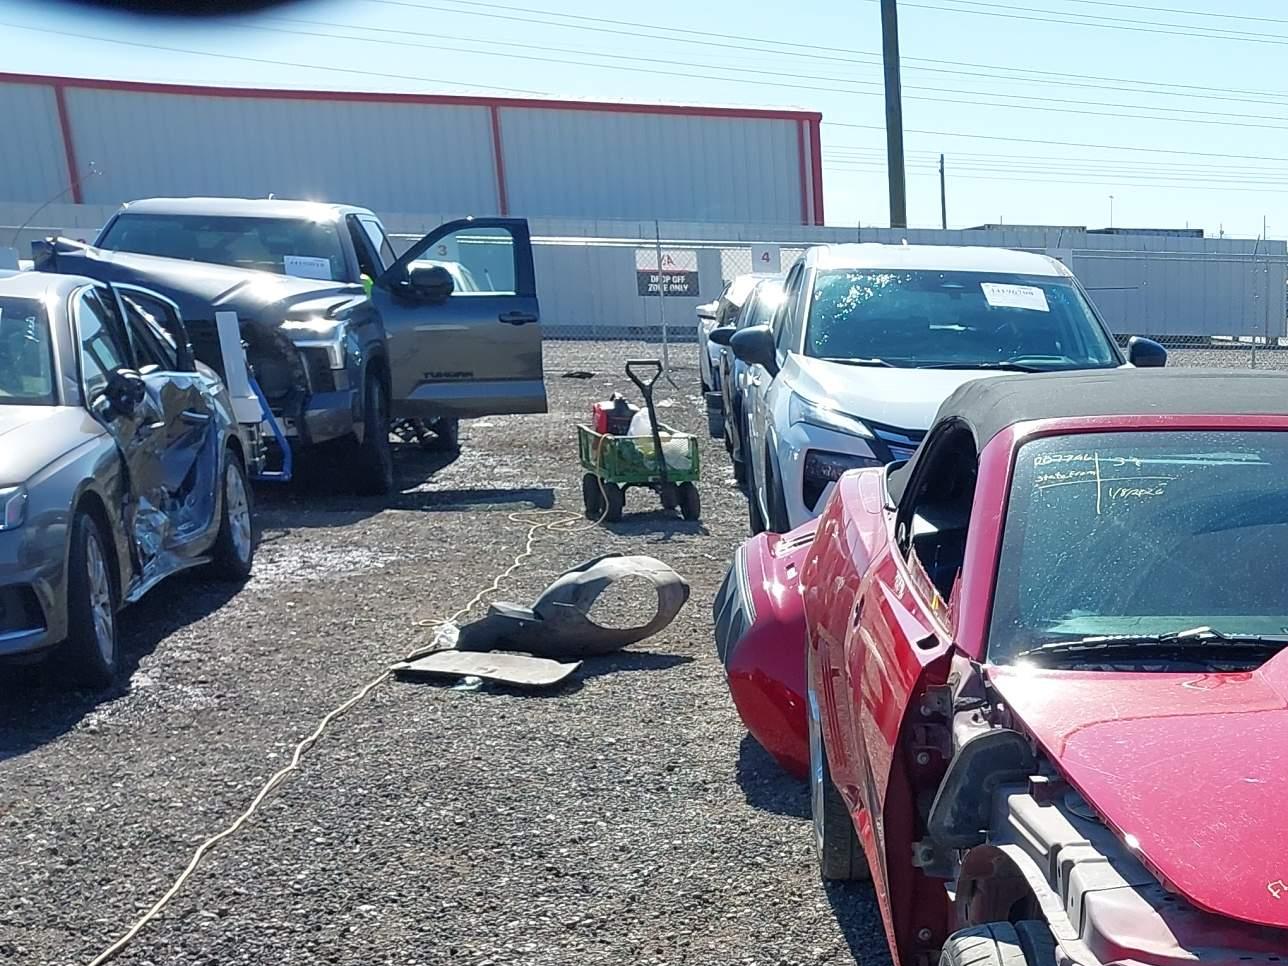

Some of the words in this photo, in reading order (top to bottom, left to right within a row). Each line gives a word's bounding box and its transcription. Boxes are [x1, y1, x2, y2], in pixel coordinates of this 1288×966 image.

[437, 244, 448, 257] 3
[761, 251, 770, 263] 4
[672, 275, 686, 283] OFF
[669, 283, 689, 292] ONLY
